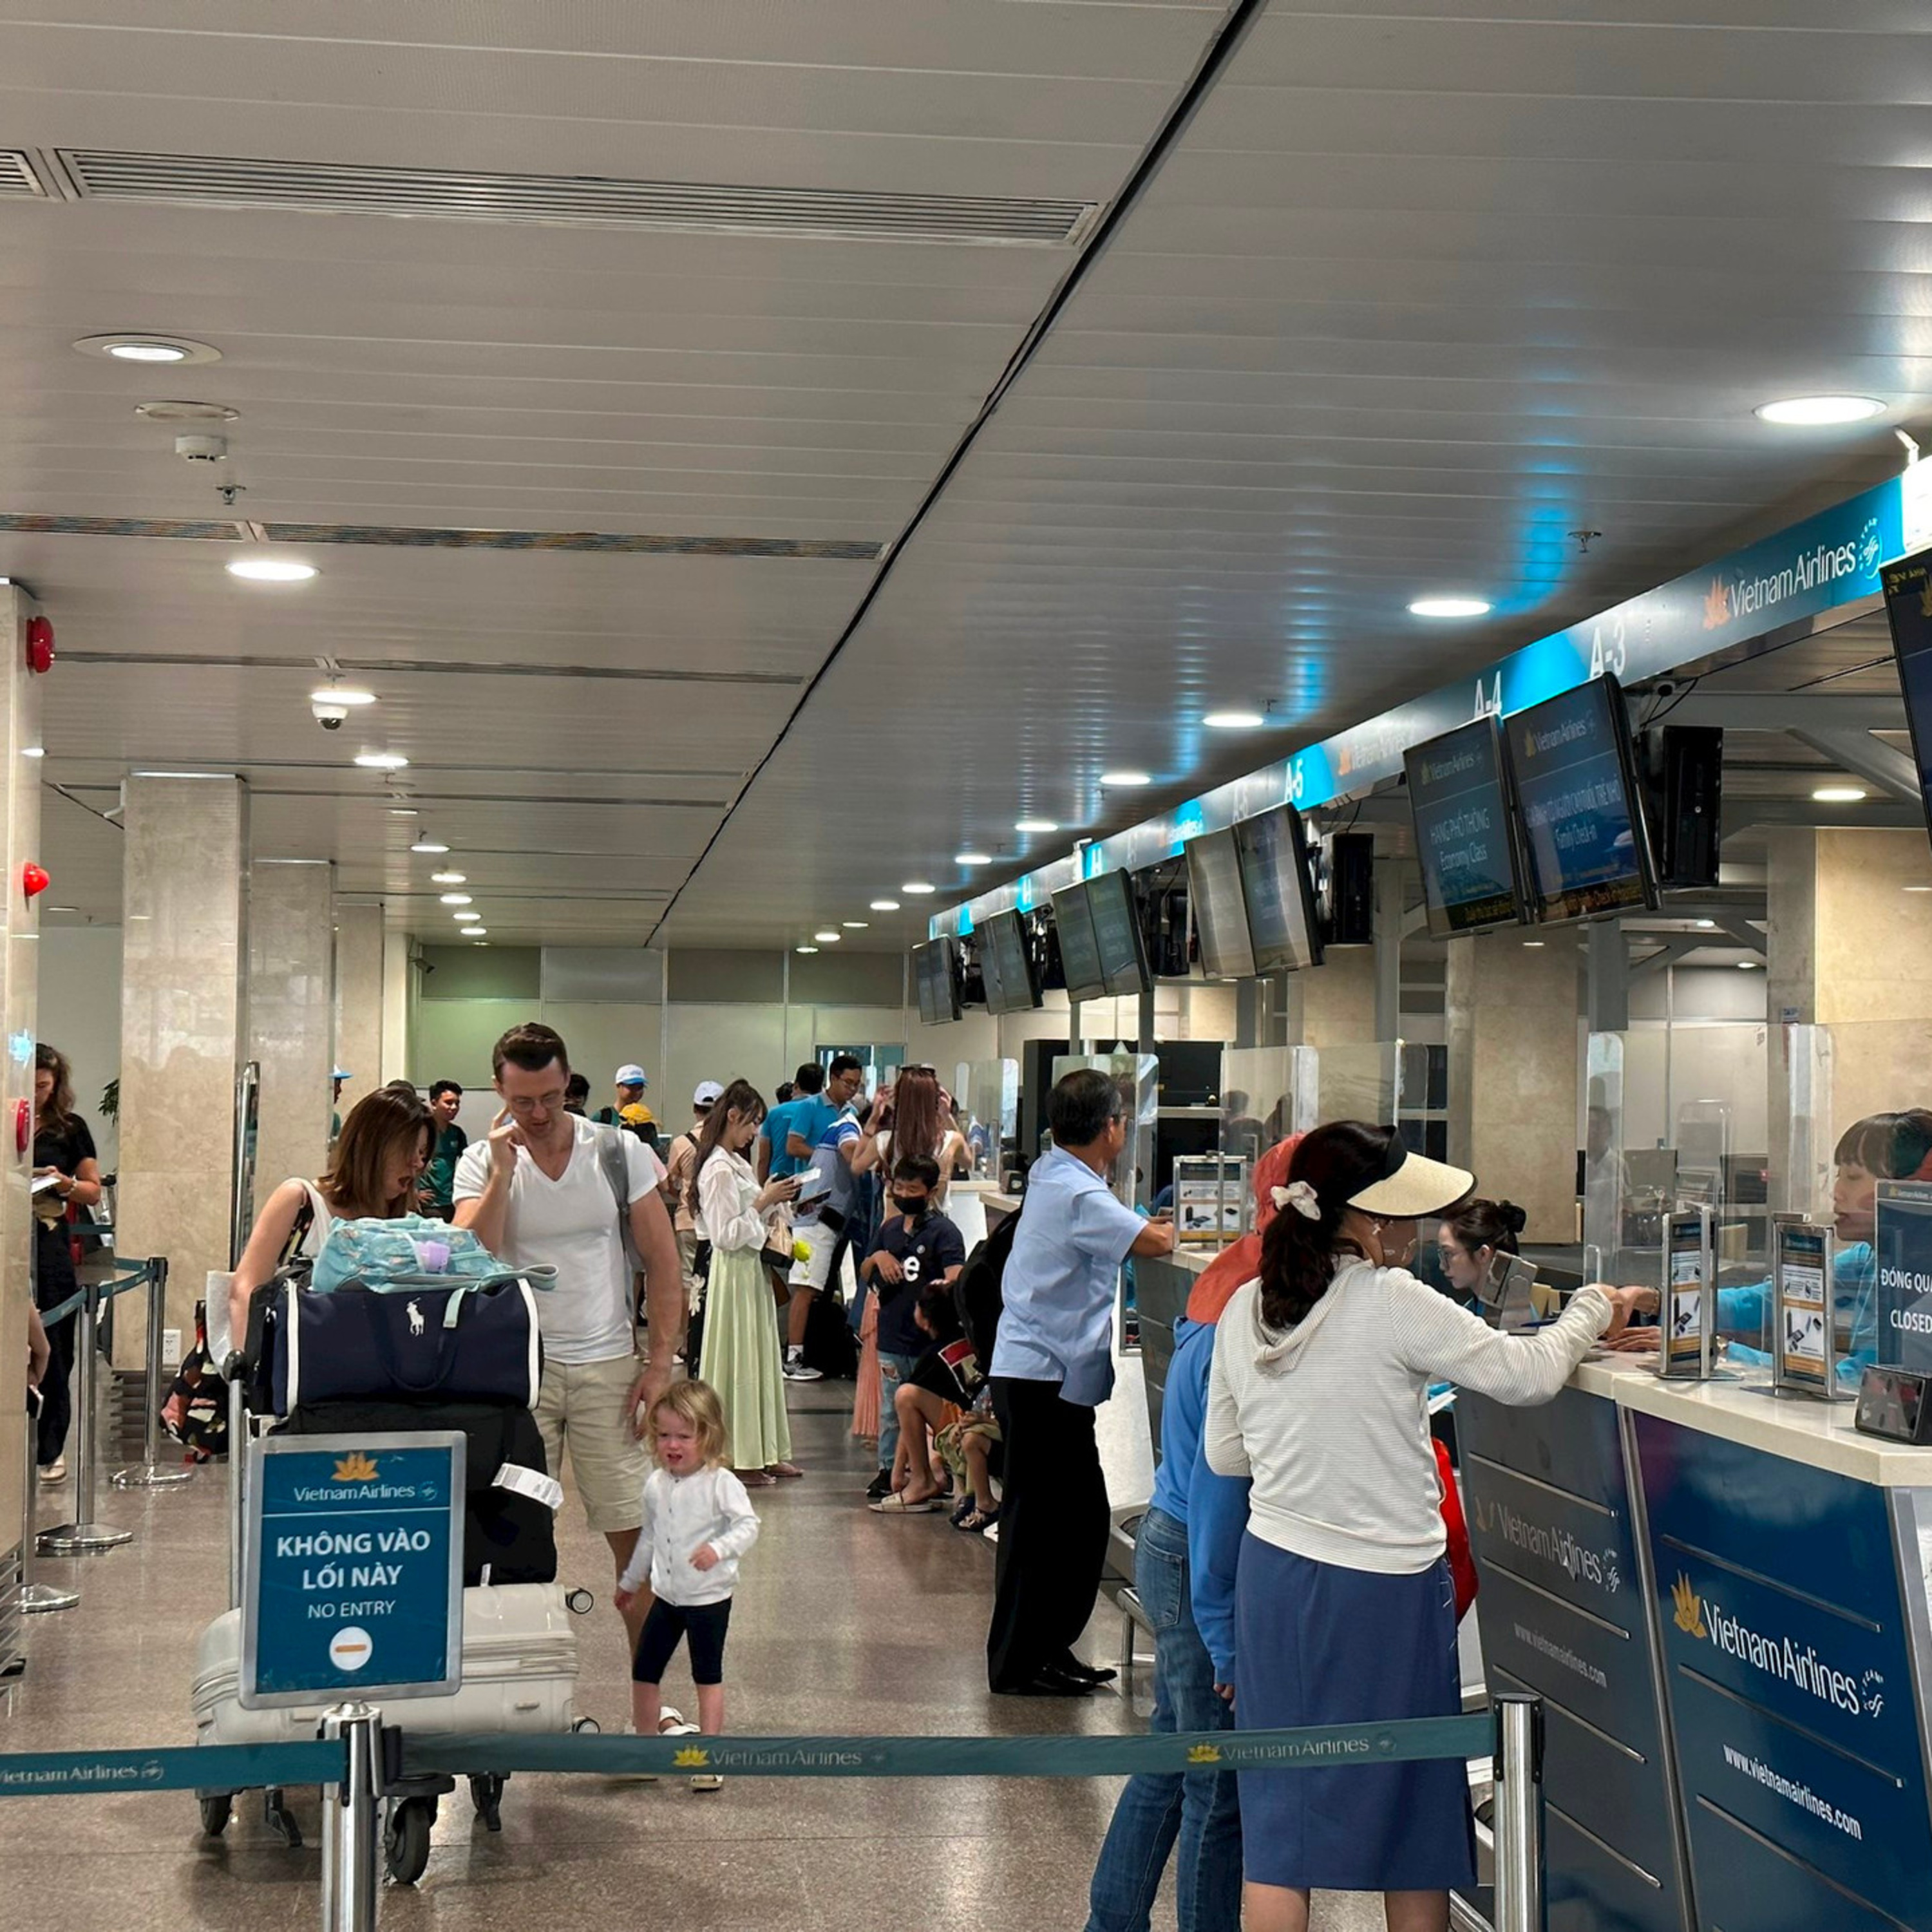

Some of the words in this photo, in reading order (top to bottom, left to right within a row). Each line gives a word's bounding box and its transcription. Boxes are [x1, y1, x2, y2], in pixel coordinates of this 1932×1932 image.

[1731, 568, 1794, 617] Vietnam
[1794, 542, 1856, 594] Airlines
[1589, 620, 1625, 679] A-3
[1474, 670, 1502, 718] A-4
[1285, 757, 1303, 802] A-5
[1880, 1265, 1912, 1290] ĐÓNG
[1914, 1273, 1932, 1293] QU
[1890, 1309, 1932, 1333] CLOSED
[294, 1486, 357, 1502] Vietnam
[358, 1483, 415, 1499] Airlines
[276, 1530, 372, 1558] KHÔNG
[377, 1526, 431, 1553] VÀO
[1497, 1502, 1555, 1562] Vietnam
[303, 1561, 345, 1590] LỐI
[351, 1561, 403, 1588] NÀY
[308, 1603, 336, 1619] NO
[340, 1600, 396, 1618] ENTRY
[1703, 1598, 1783, 1678] Vietnam
[1783, 1636, 1860, 1715] Airlines
[712, 1748, 790, 1766] Vietnam
[791, 1748, 862, 1766] Airlines
[1224, 1744, 1300, 1761] Vietnam
[1301, 1737, 1370, 1756] Airlines
[70, 1764, 138, 1780] Airlines
[1723, 1743, 1862, 1841] www.vietnamairlines.com
